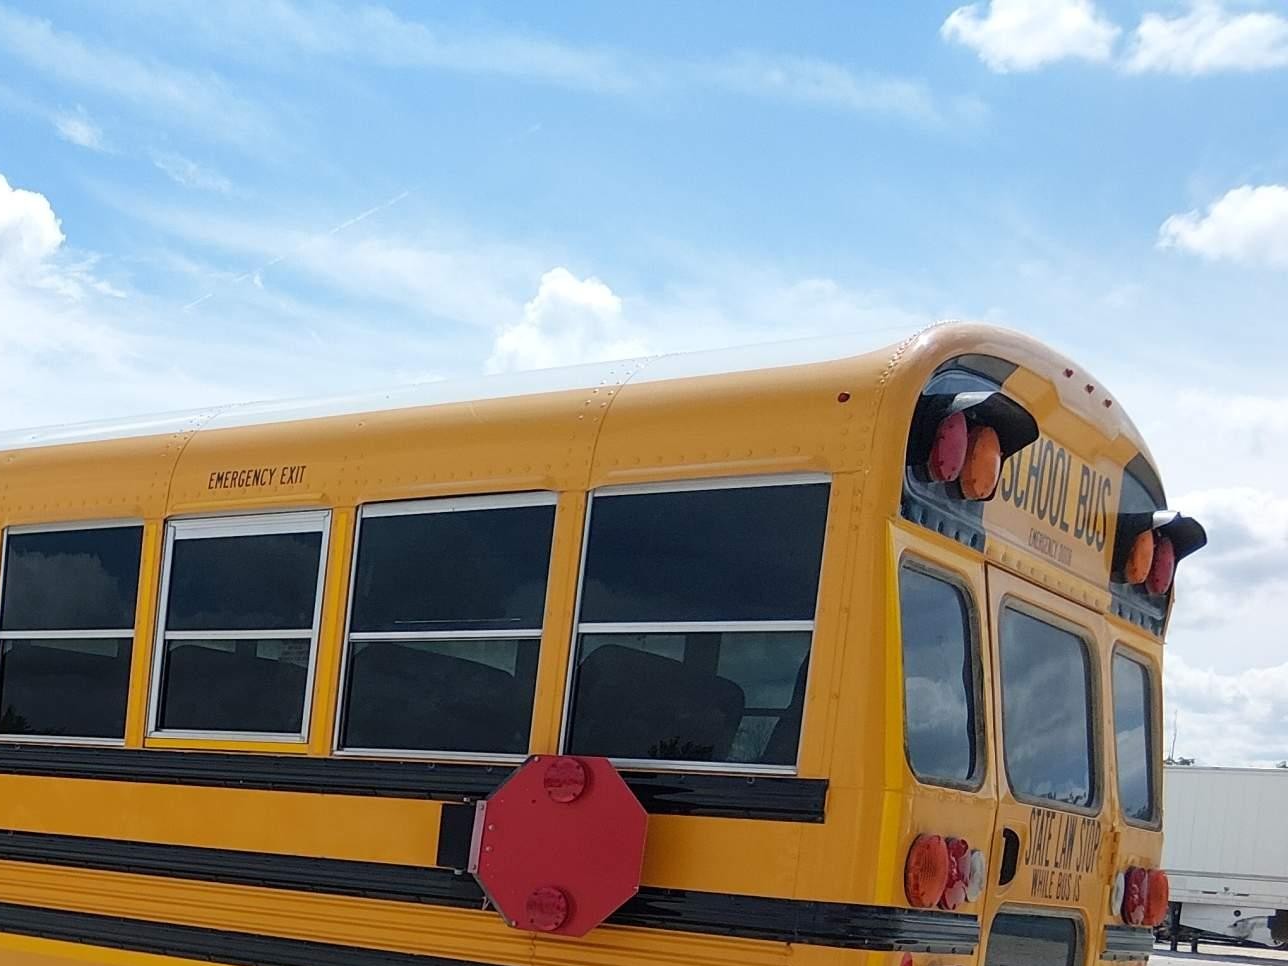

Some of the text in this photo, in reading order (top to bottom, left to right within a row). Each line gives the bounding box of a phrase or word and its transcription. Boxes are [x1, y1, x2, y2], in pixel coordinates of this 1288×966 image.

[208, 465, 307, 489] EMERGENCY EXIT
[1073, 463, 1111, 552] BUS
[1025, 807, 1101, 873] STATE LAW STOP
[1031, 868, 1082, 903] WHILE BUS IS
